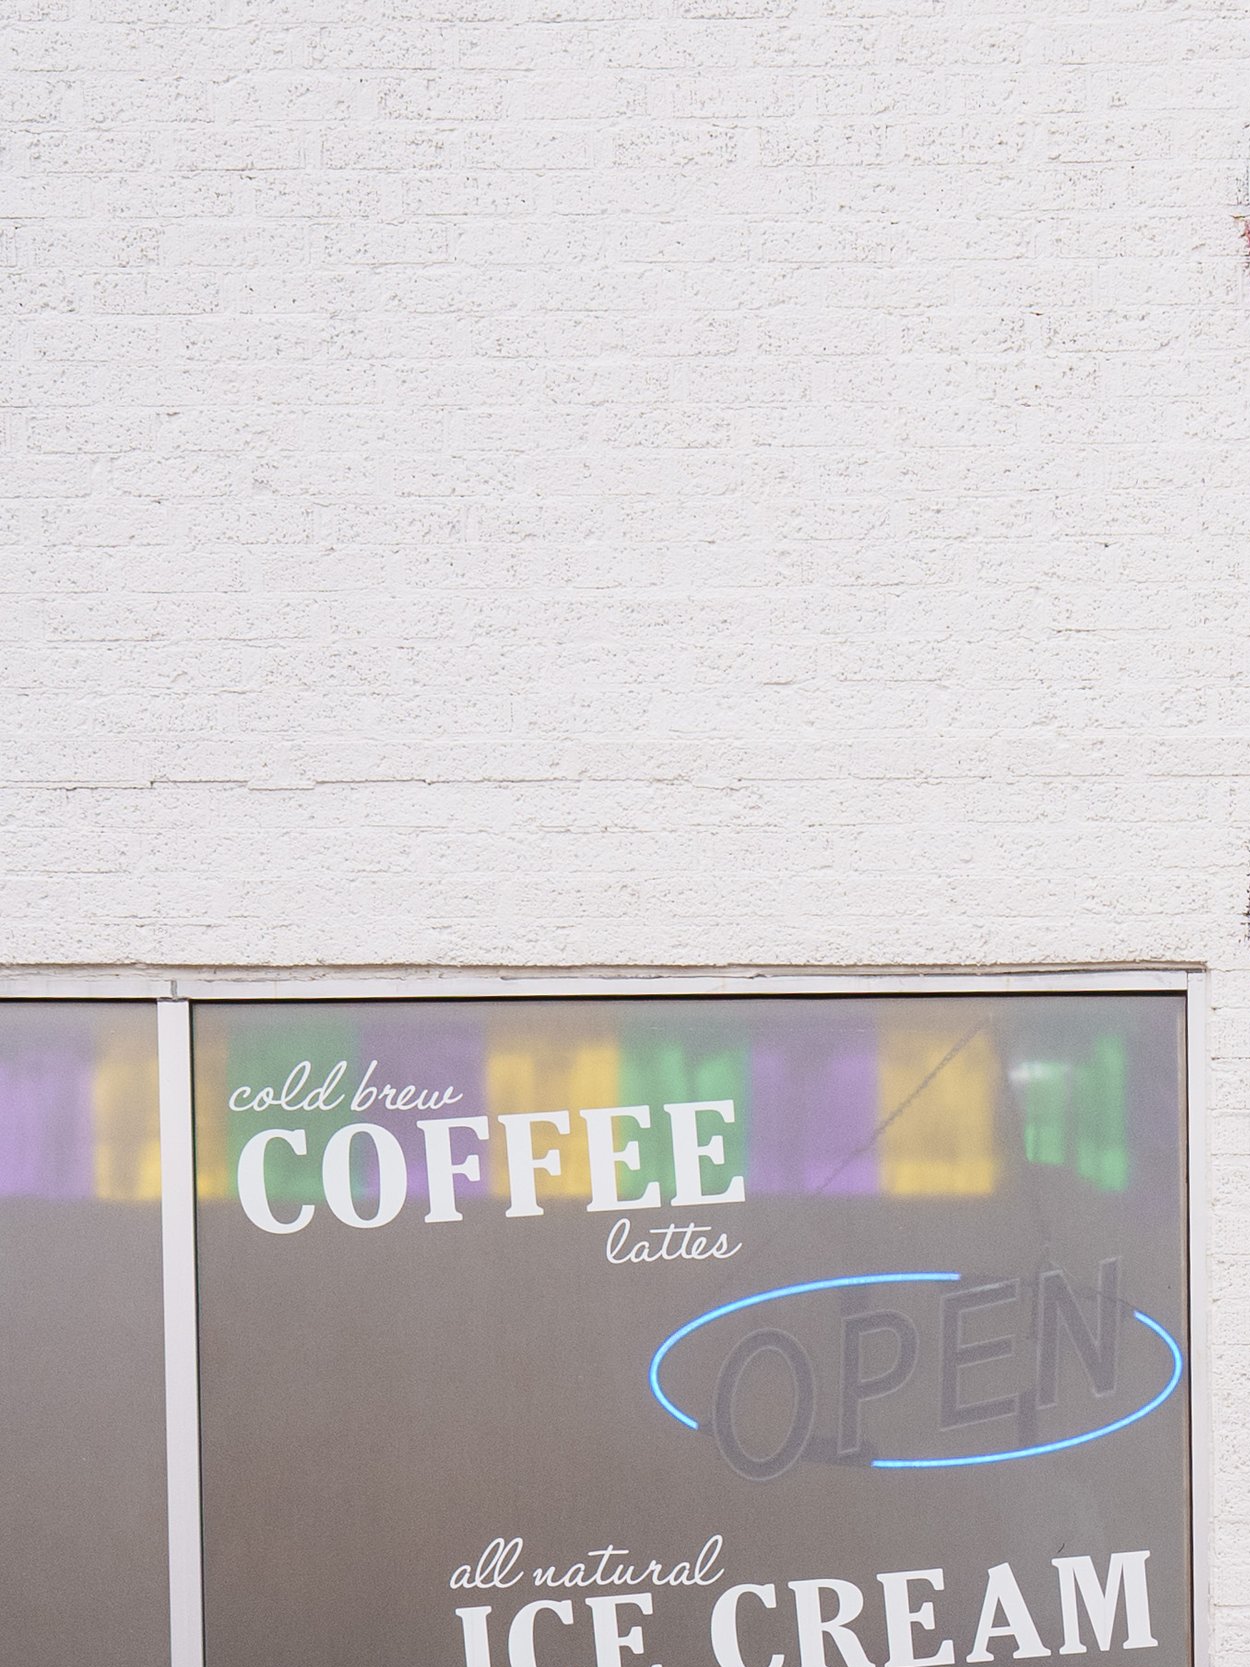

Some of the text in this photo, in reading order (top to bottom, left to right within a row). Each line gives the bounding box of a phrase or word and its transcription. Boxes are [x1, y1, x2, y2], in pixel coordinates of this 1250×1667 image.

[228, 1059, 464, 1112] cold brew
[237, 1099, 746, 1234] COFFEE
[605, 1218, 743, 1264] lattes
[713, 1256, 1122, 1482] OPEN
[449, 1534, 725, 1589] all natural
